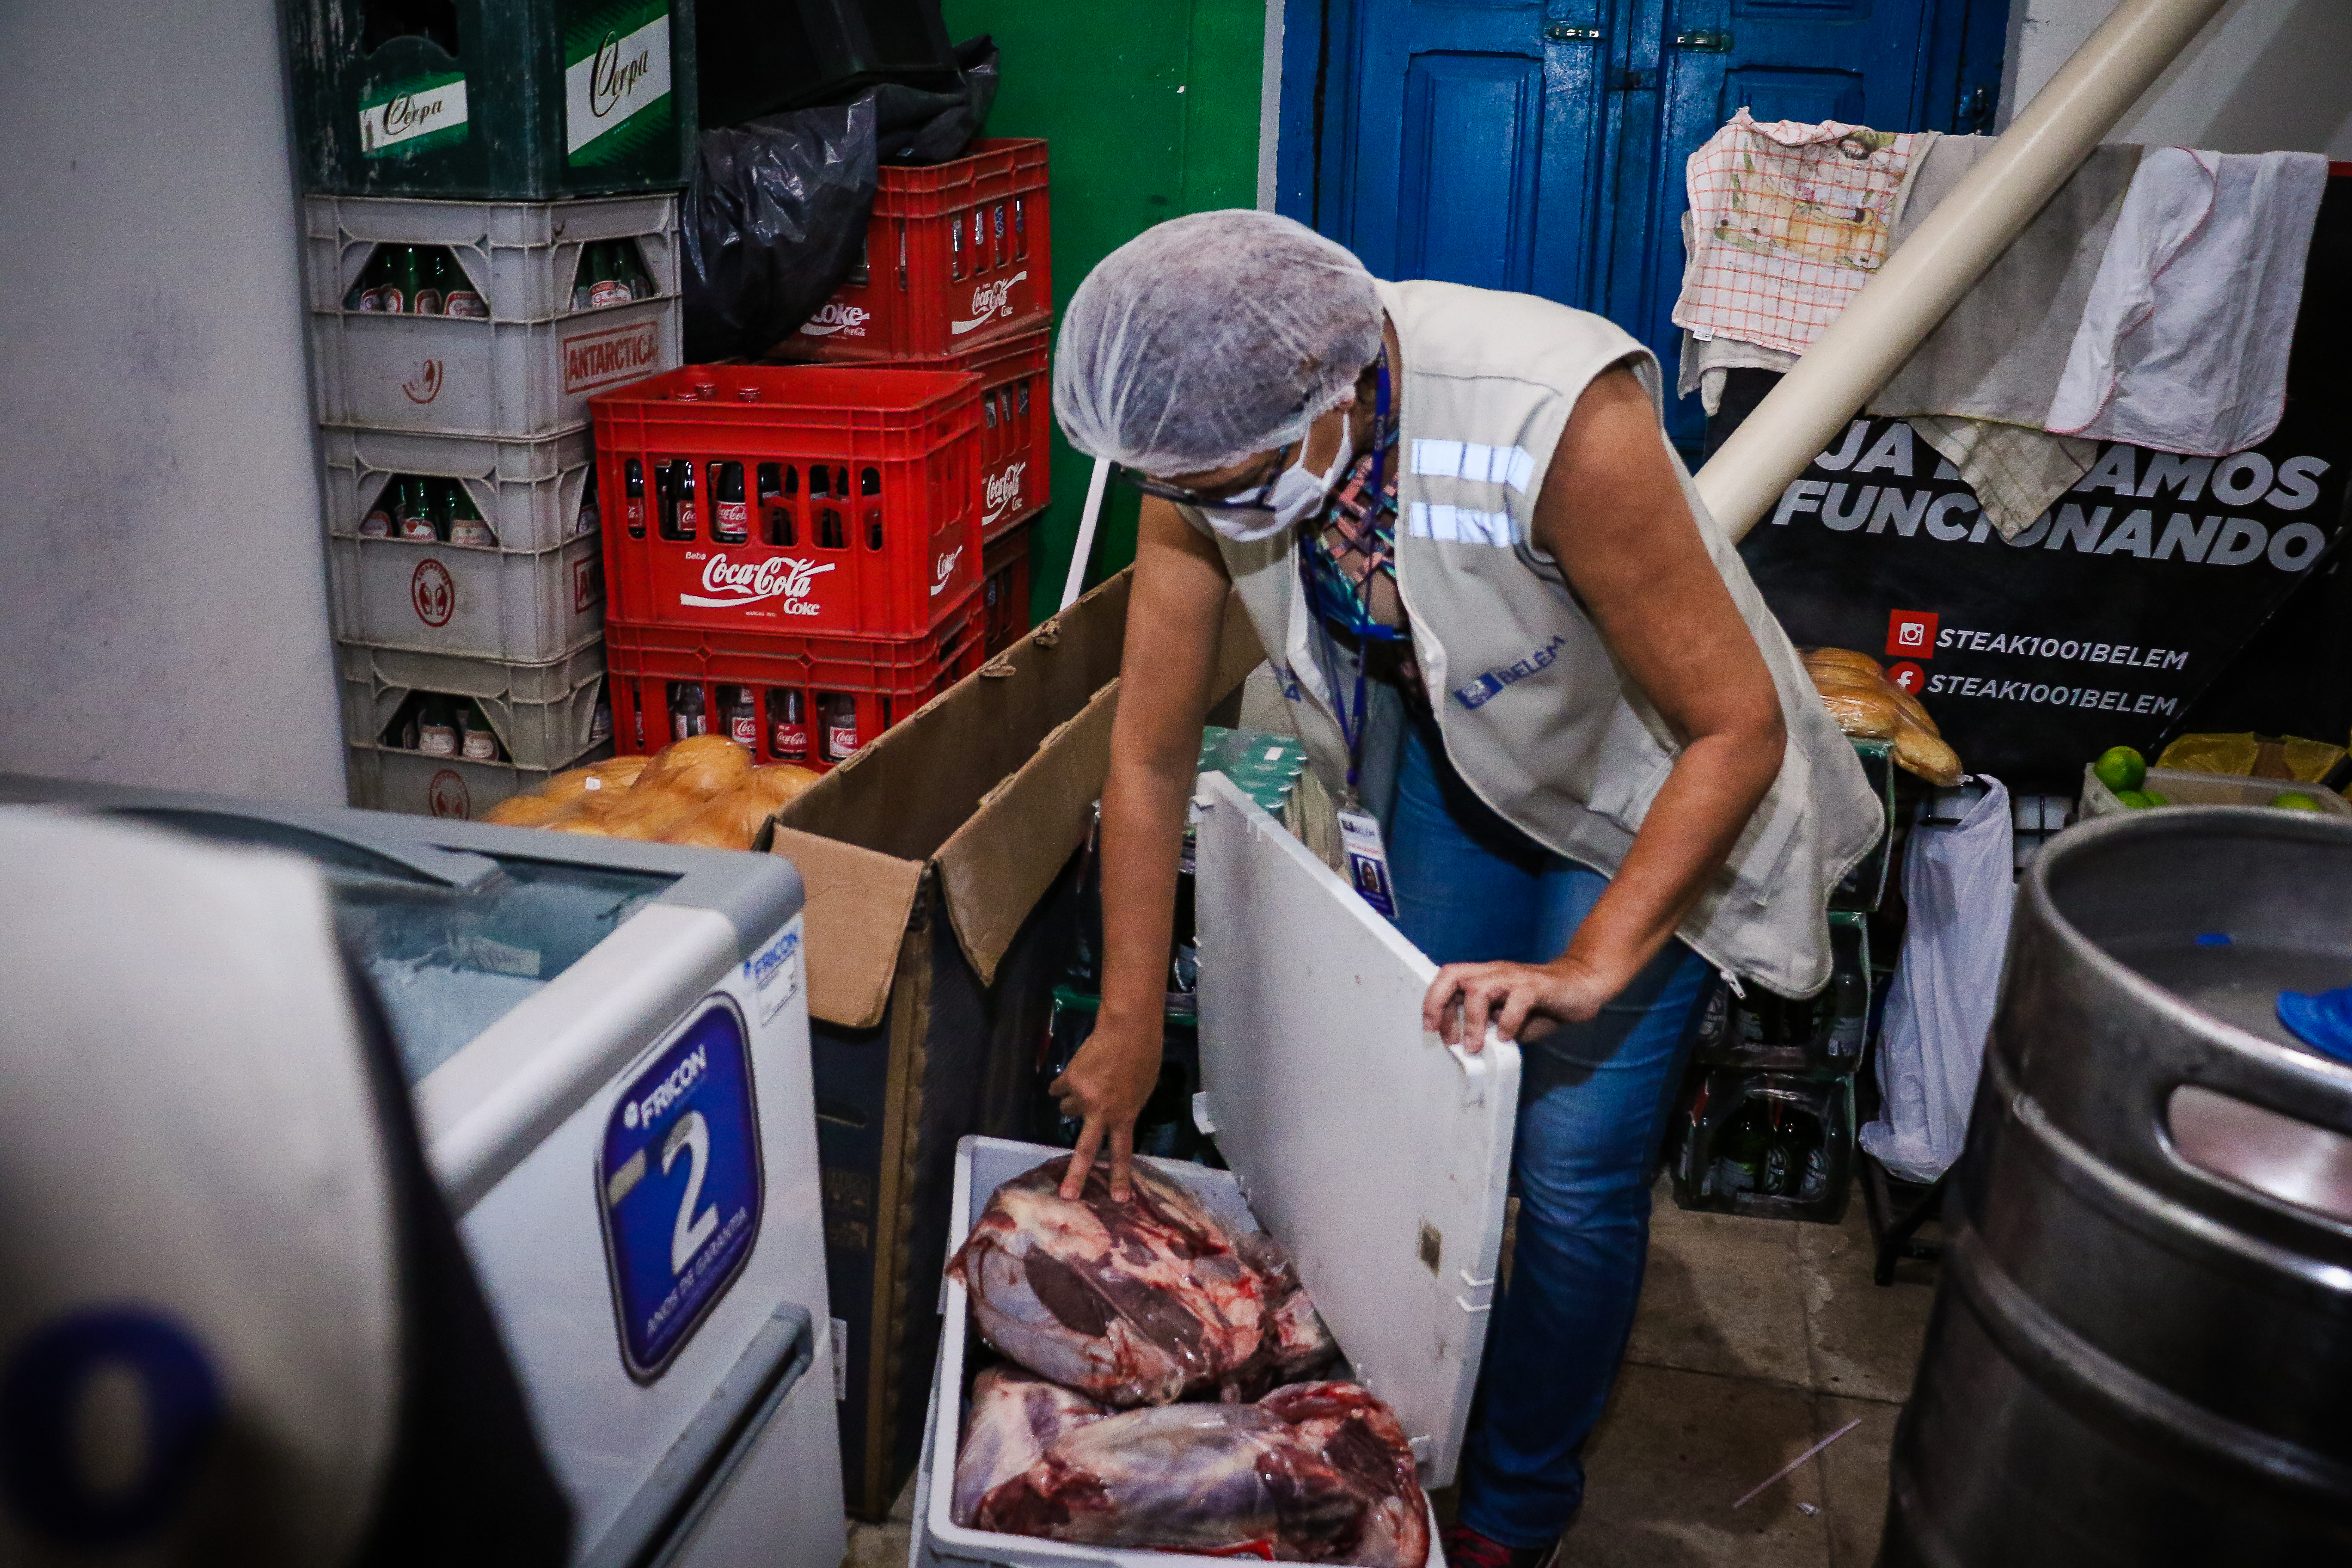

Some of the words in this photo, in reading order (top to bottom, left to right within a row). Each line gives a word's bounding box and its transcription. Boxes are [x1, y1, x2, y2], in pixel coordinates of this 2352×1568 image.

[590, 30, 649, 118] Cerpa
[383, 92, 443, 135] Cerpa
[702, 553, 815, 597] Coca-Cola
[784, 598, 820, 616] Coke
[1936, 628, 2189, 670] STEAK1001BELEM
[1927, 674, 2178, 716] STEAK1001BELEM
[641, 1043, 707, 1130] FRICON
[662, 1109, 719, 1275] 2
